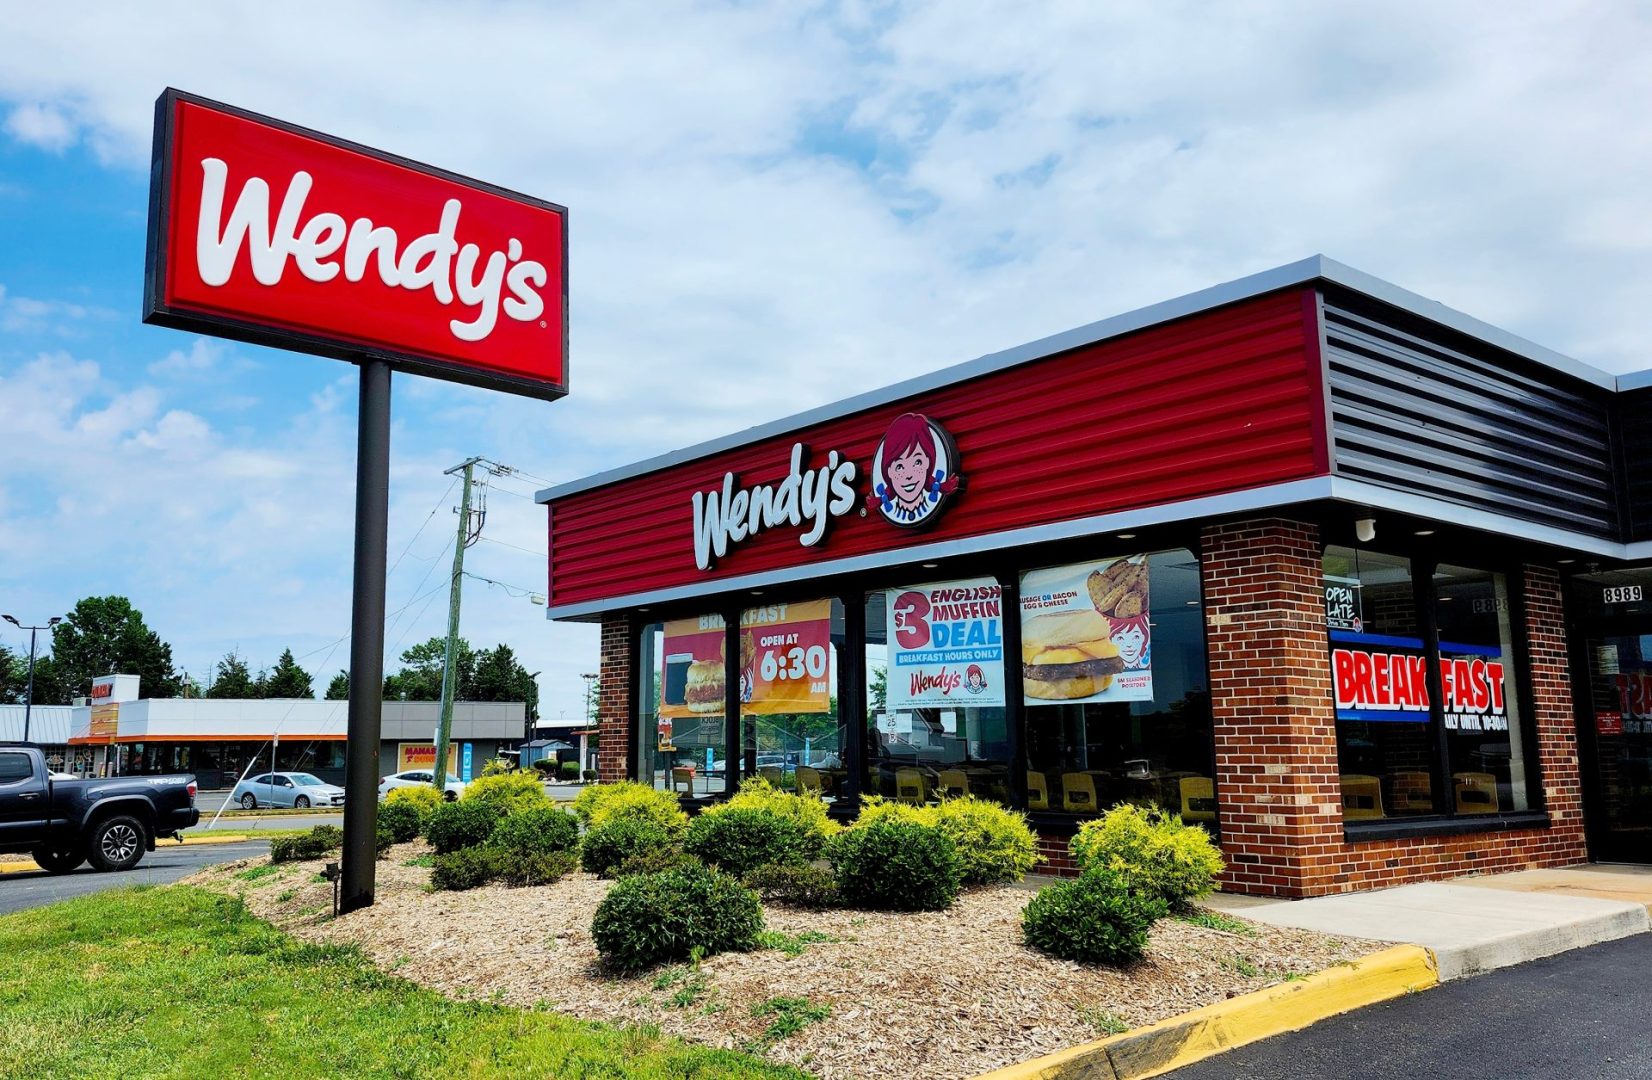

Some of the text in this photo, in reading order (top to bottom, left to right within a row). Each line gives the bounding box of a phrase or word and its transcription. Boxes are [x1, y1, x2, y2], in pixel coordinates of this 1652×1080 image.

[197, 157, 547, 342] Wendy's
[692, 442, 856, 570] Wendy's
[930, 585, 1002, 604] ENGLISH
[1043, 598, 1069, 608] CHEESE
[1052, 591, 1078, 600] BACON
[1325, 586, 1353, 604] OPEN
[1605, 586, 1642, 603] 8989
[932, 600, 1000, 621] MUFFIN
[1327, 601, 1356, 620] LATE
[760, 633, 799, 648] OPEN AT
[931, 619, 1001, 648] DEAL
[760, 645, 827, 682] 6:30
[899, 649, 999, 663] BREAKFAST HOURS ONLY
[811, 682, 827, 694] AM
[910, 665, 961, 697] Wendy's
